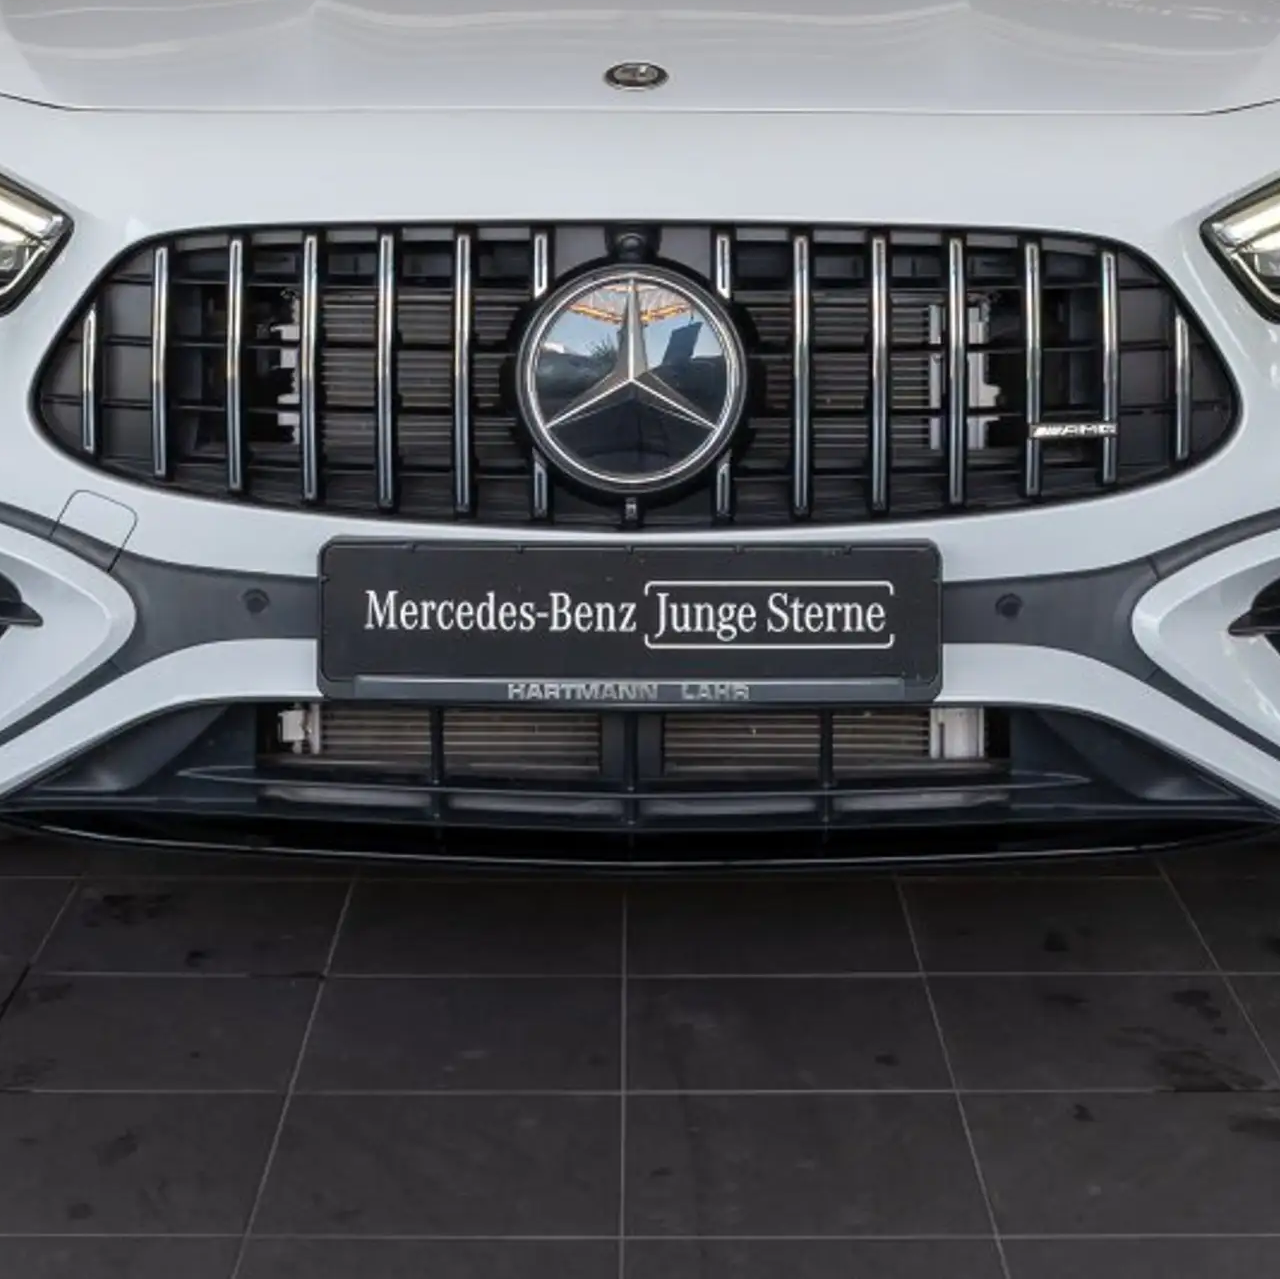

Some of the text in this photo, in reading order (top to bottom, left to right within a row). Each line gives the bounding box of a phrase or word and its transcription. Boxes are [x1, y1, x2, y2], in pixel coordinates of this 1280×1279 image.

[364, 589, 887, 642] Mercedes-Benz Junge Sterne
[507, 682, 750, 701] HARTMANN LAHR
